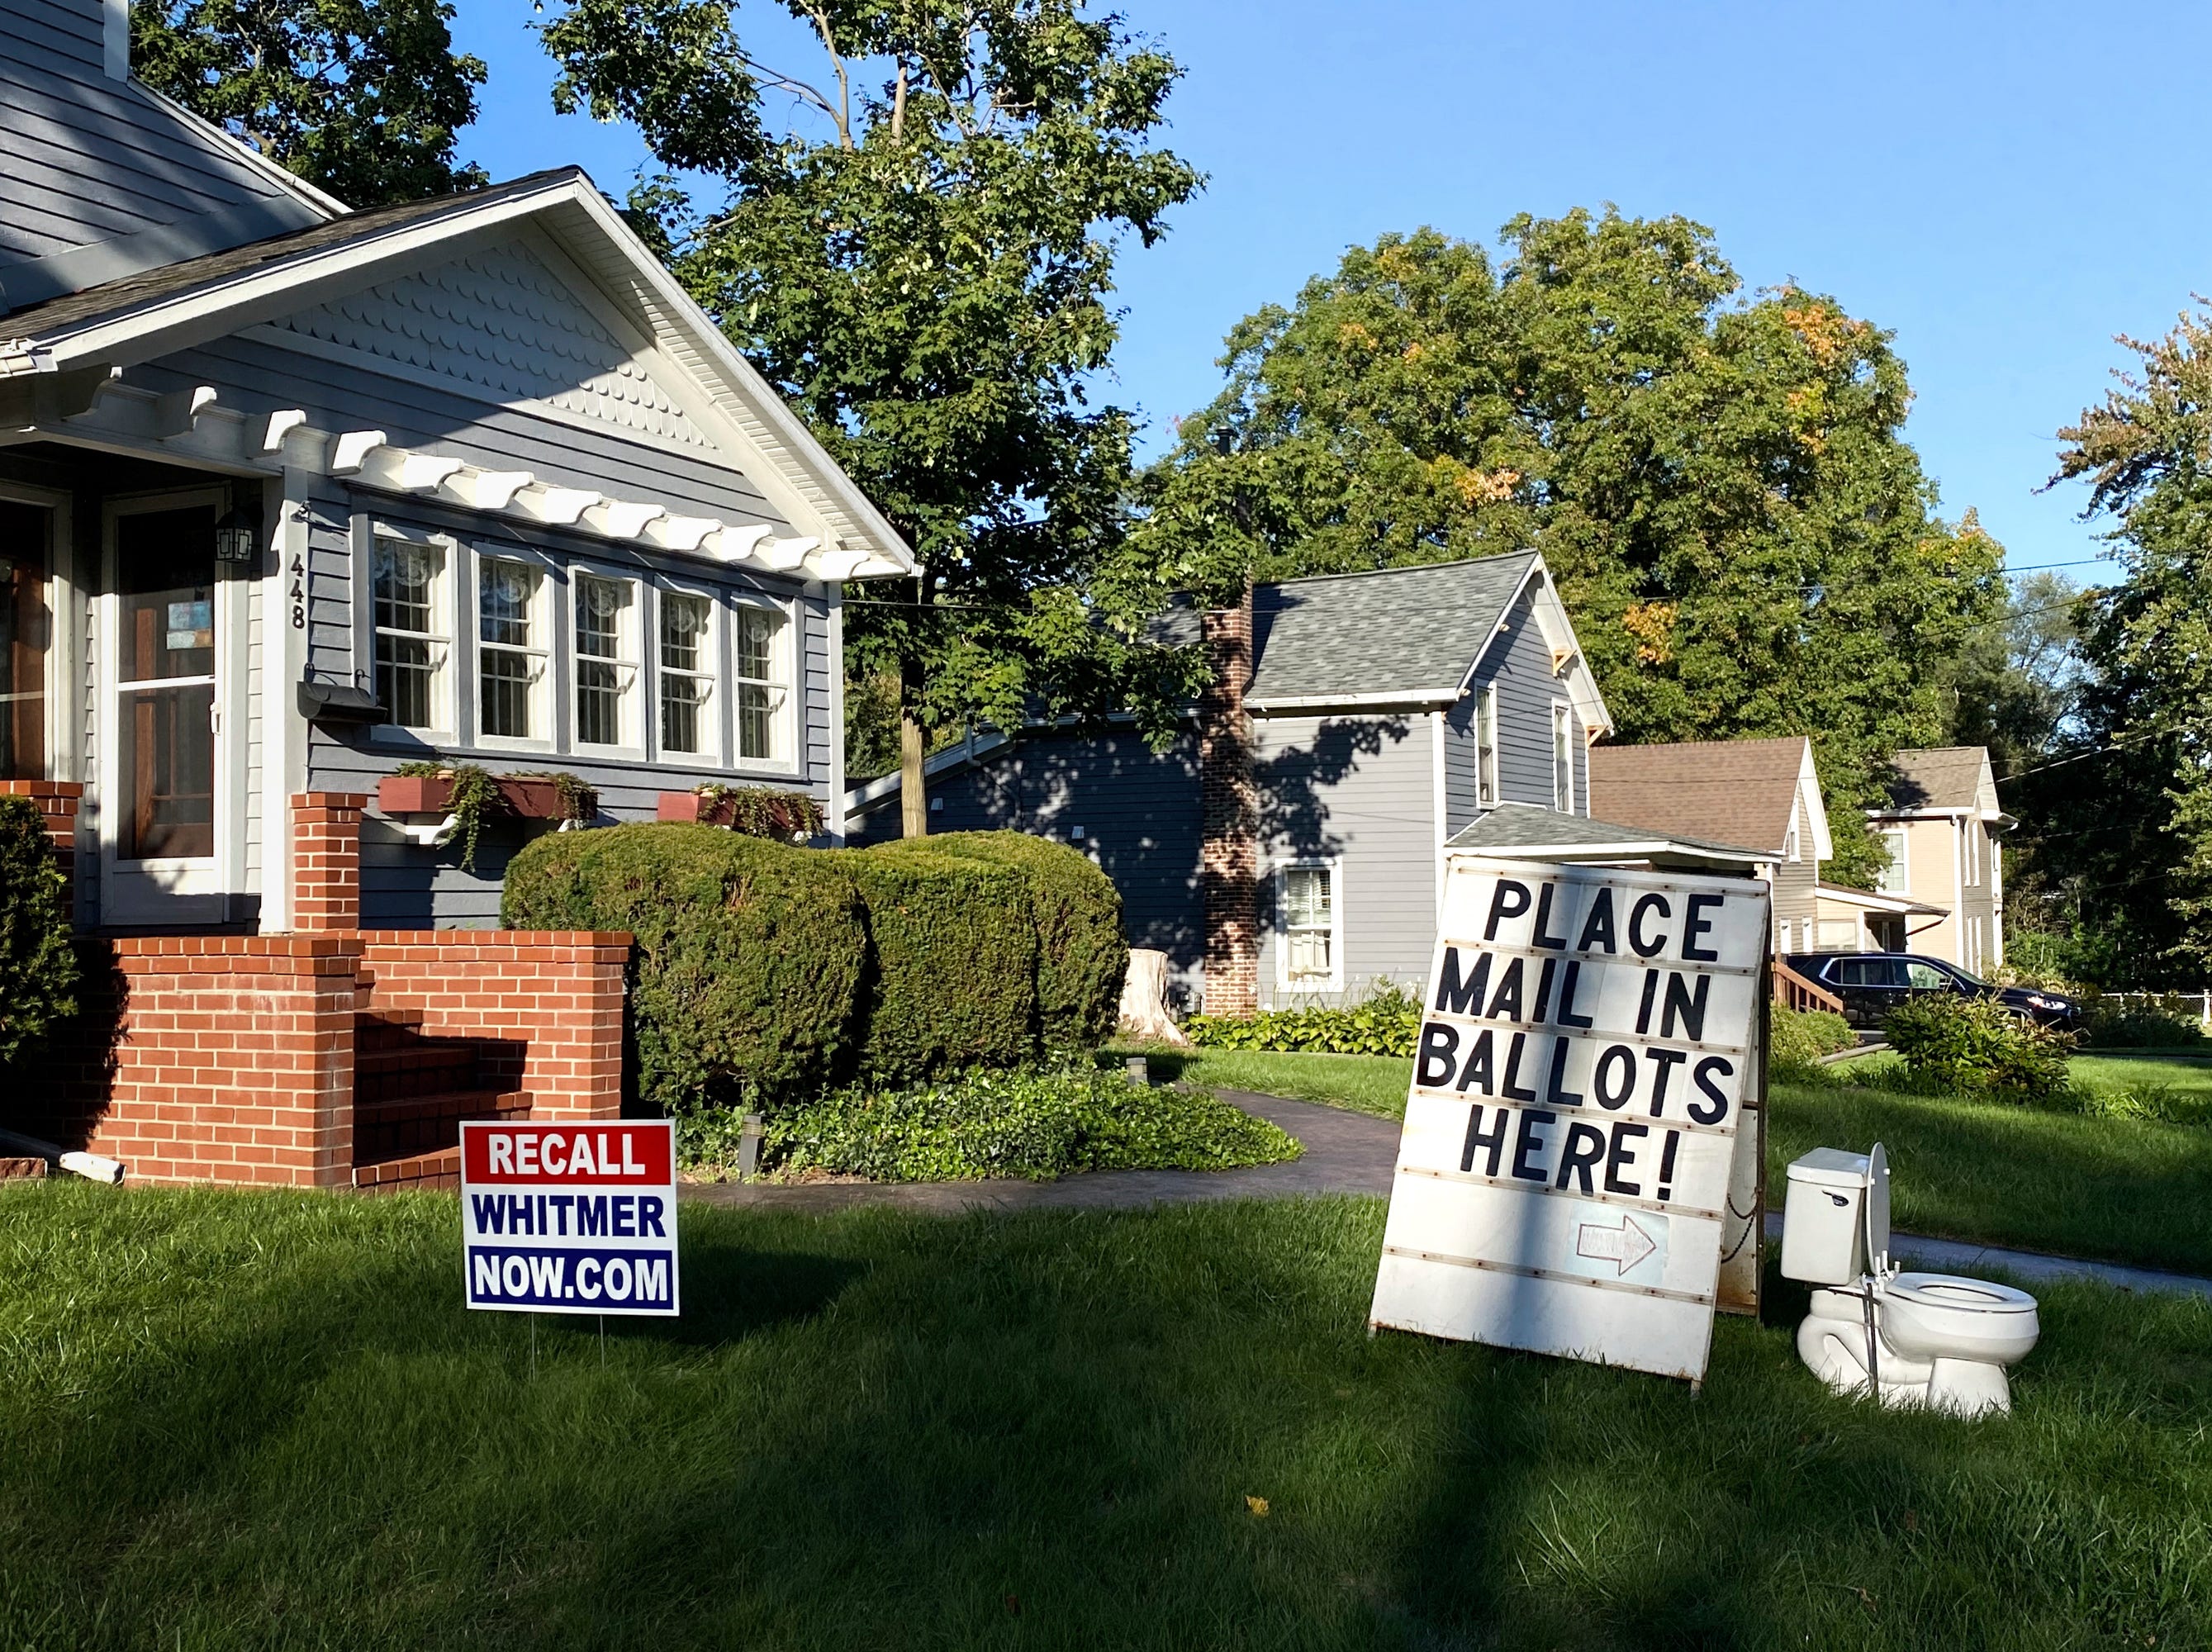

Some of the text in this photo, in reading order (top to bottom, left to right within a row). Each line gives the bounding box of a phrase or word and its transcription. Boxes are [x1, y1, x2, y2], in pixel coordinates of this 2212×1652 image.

[290, 553, 305, 629] 448
[1483, 879, 1724, 961] PLACE
[1435, 947, 1710, 1041] MAIL IN
[1417, 1022, 1734, 1125] BALLOTS
[488, 1134, 645, 1175] RECALL
[1460, 1104, 1680, 1201] HERE!
[471, 1194, 667, 1237] WHITMER
[474, 1255, 667, 1300] NOW.COM
